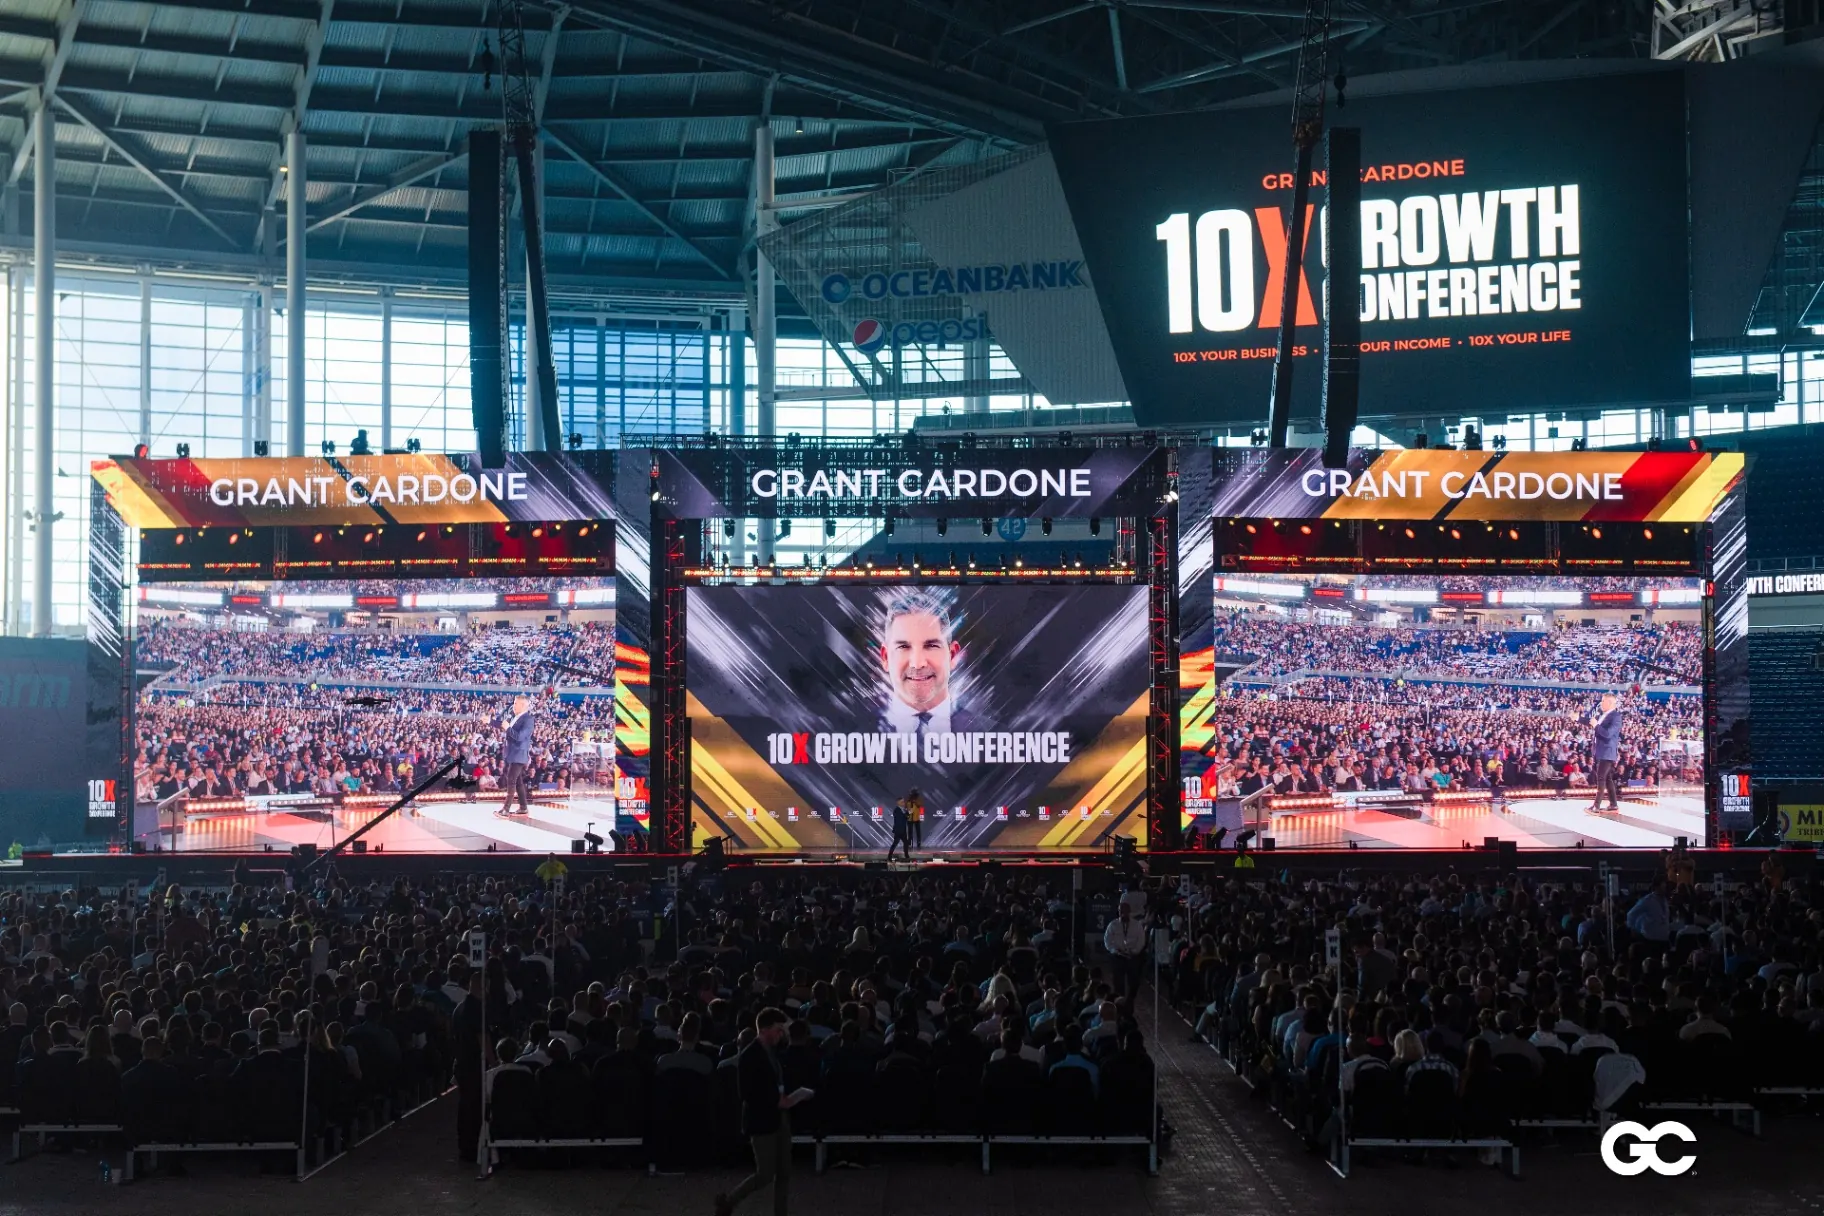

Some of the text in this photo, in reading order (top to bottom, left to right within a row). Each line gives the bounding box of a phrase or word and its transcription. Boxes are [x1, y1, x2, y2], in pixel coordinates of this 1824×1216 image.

[1262, 159, 1464, 190] GRN ARDONE
[1320, 183, 1580, 269] ROWTH
[862, 260, 1085, 300] OCEANBANK
[1156, 203, 1318, 334] 10X
[1322, 260, 1581, 322] ONFERENCE
[891, 311, 988, 351] pepsi
[1173, 330, 1571, 363] 10X YOUR BUSINSS OUR INCOME 10X YOUR LIFE
[210, 472, 528, 507] GRANT CARDONE
[752, 468, 1092, 498] GRANT CARDONE
[1301, 469, 1624, 500] GRANT CARDONE
[767, 731, 1070, 764] 10X GROWTH CONFERENCE
[88, 779, 116, 802] 10X
[618, 777, 646, 799] 10X
[1183, 776, 1211, 798] 10X
[1721, 775, 1750, 796] 10X
[472, 949, 482, 961] M
